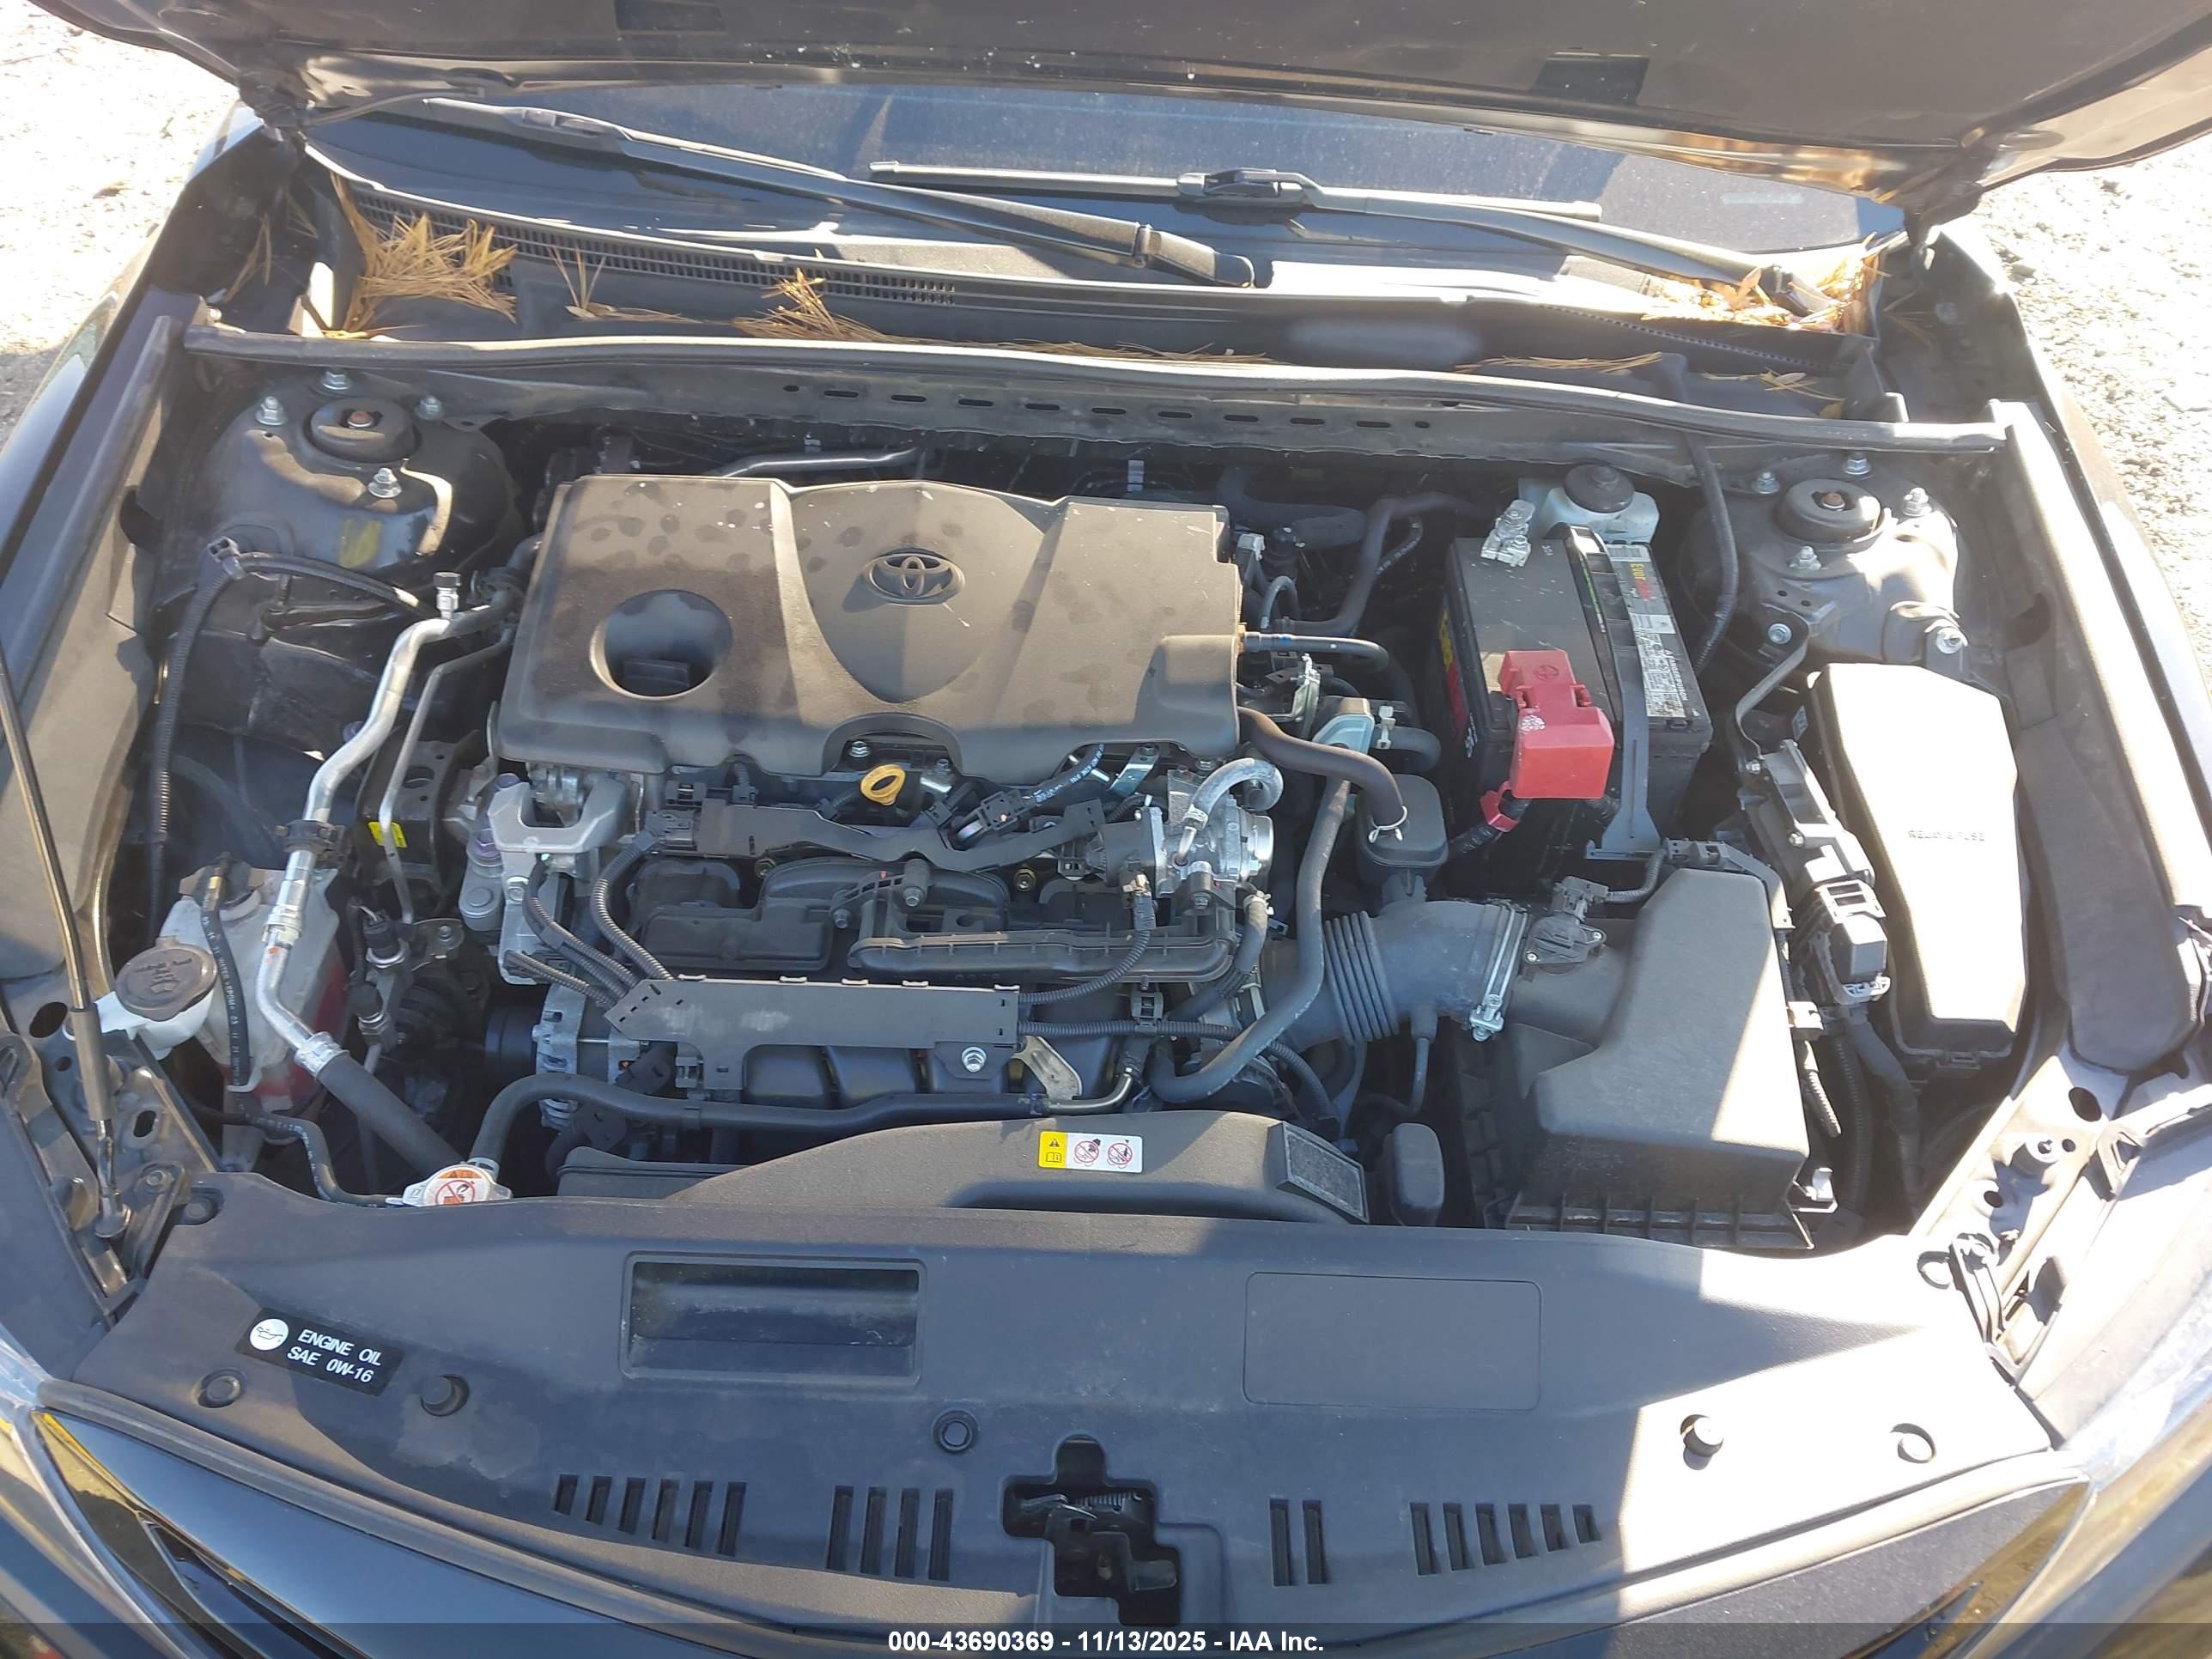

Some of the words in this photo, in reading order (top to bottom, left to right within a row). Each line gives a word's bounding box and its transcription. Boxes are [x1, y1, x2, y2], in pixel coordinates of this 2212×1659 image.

[287, 1346, 322, 1366] SAE
[326, 1358, 374, 1383] 0W-16
[298, 1328, 355, 1357] ENGINE
[359, 1348, 384, 1367] OIL
